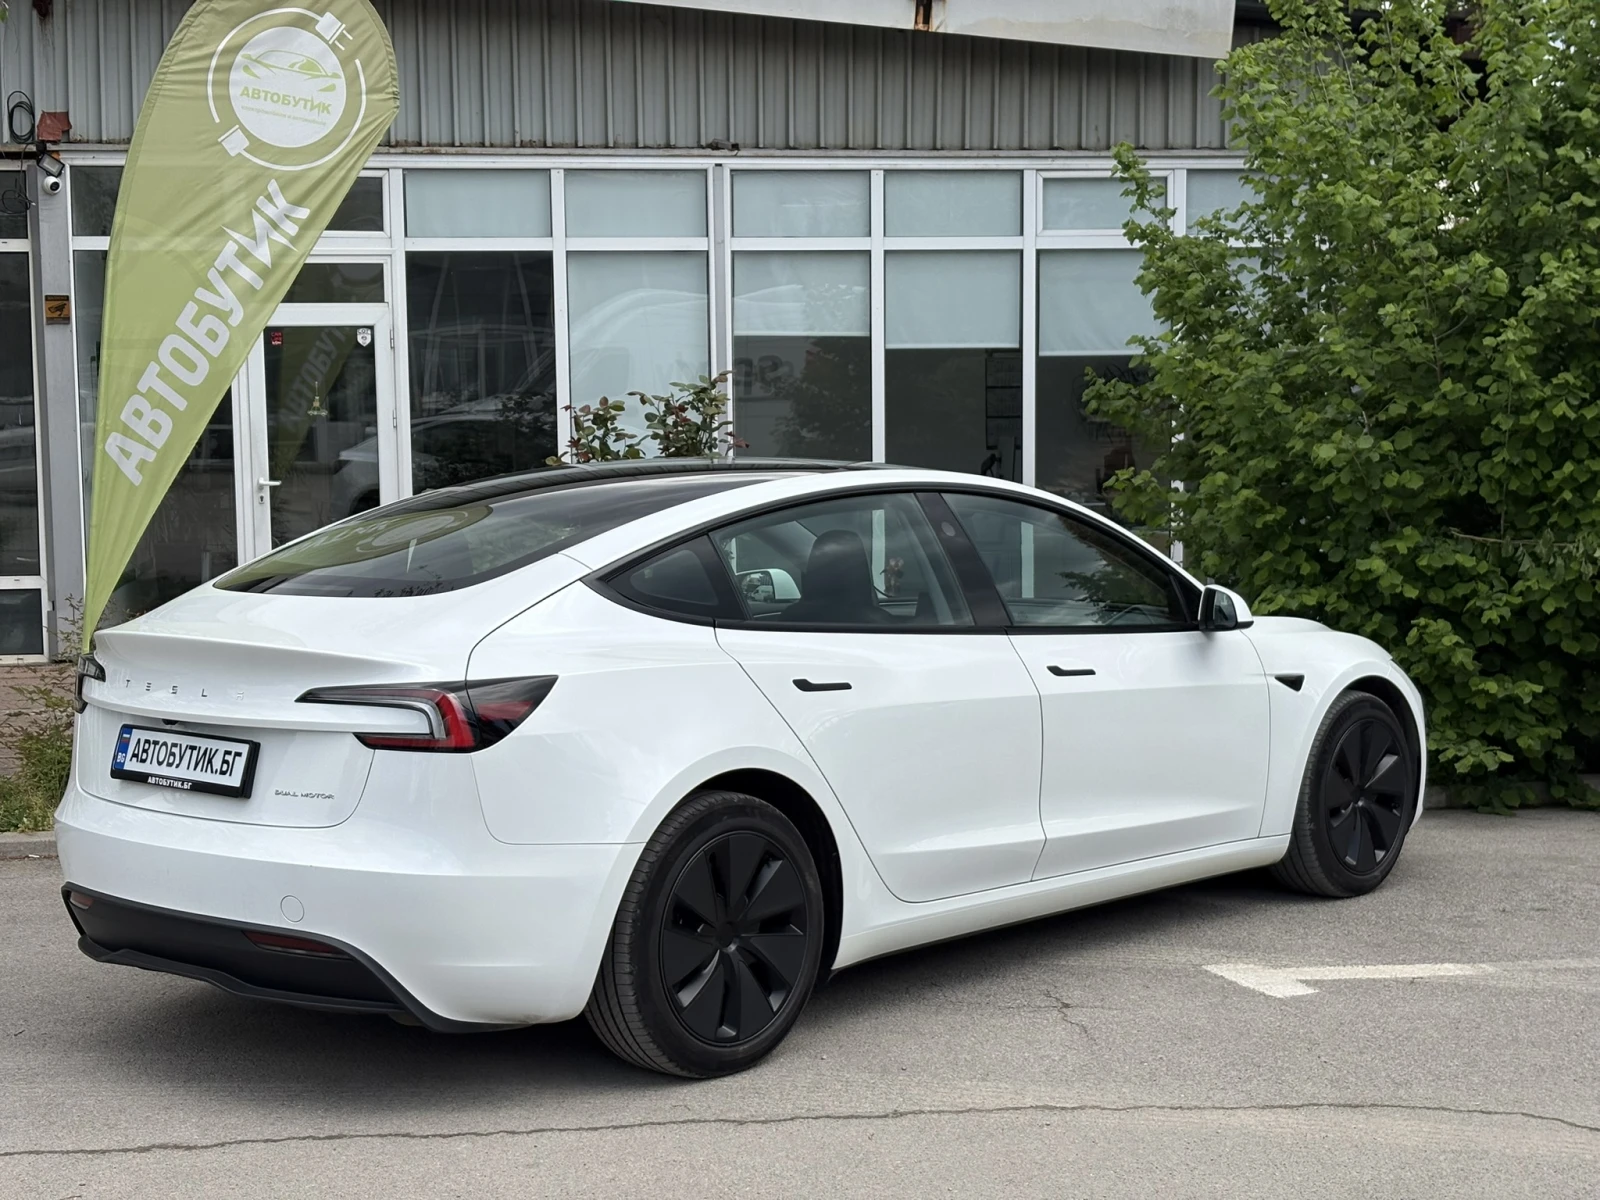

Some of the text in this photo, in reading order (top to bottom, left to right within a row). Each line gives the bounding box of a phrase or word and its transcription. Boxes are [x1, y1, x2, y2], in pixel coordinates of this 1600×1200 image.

[240, 86, 332, 117] АВТОБУТИК
[104, 178, 311, 486] АВТОБУТИК
[125, 679, 245, 701] TESLA
[117, 752, 126, 763] BG
[129, 738, 243, 777] АВТОБУТИК.БГ
[147, 776, 193, 790] АВТОБУТИК.БГ
[274, 789, 335, 800] DUAL MOTOR
